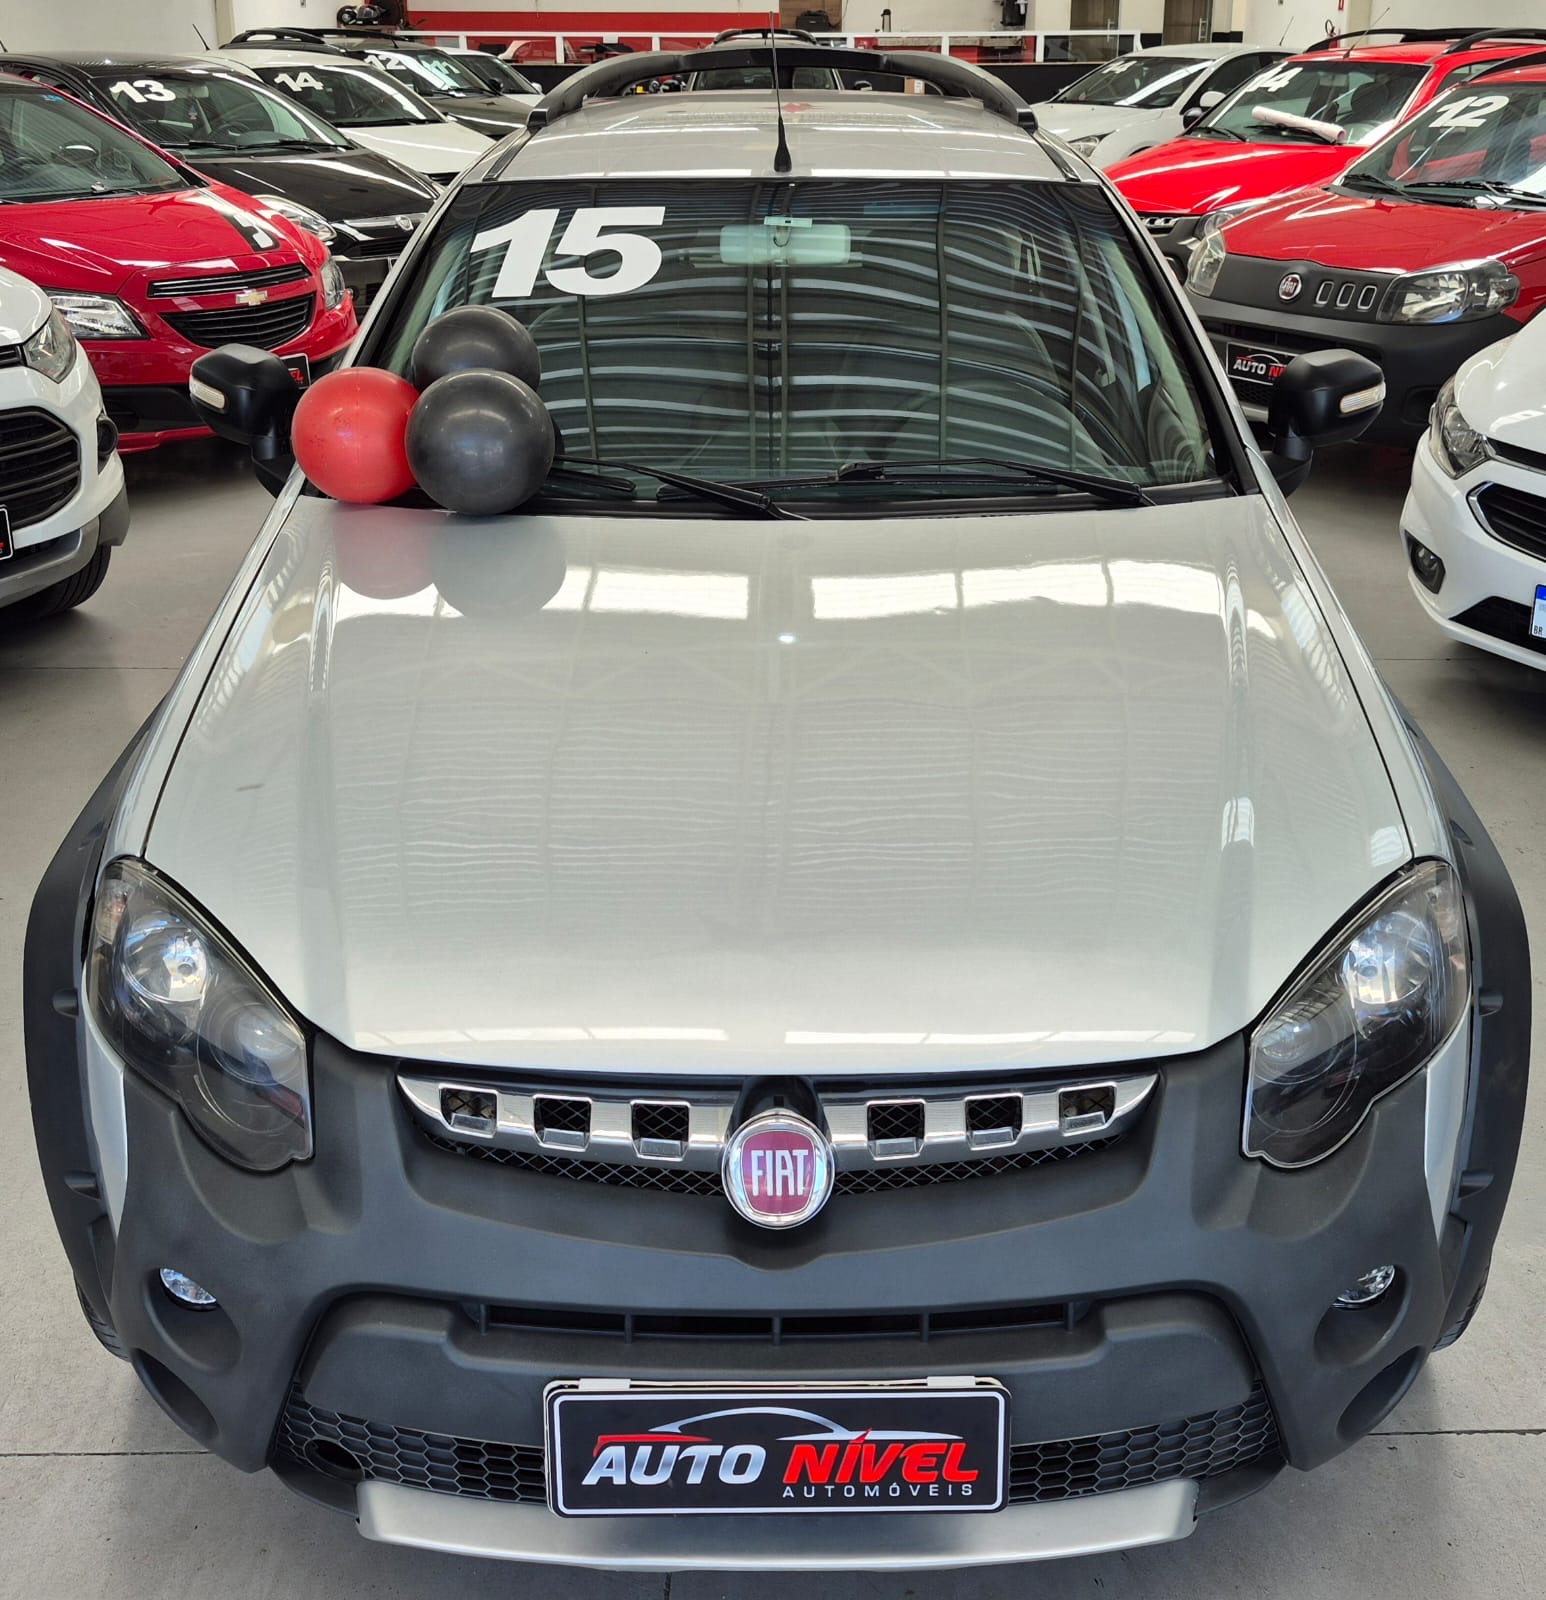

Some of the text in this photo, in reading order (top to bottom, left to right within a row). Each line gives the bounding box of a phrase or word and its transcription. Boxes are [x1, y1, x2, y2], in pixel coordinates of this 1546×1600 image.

[109, 80, 176, 103] 13
[274, 72, 324, 91] 14
[1428, 96, 1510, 127] 12
[470, 206, 666, 298] 15
[1233, 360, 1266, 374] AUTO
[751, 1149, 809, 1197] FIAT
[582, 1428, 979, 1486] AUTO NÍVEL
[783, 1482, 973, 1499] AUTOMÓVEIS
